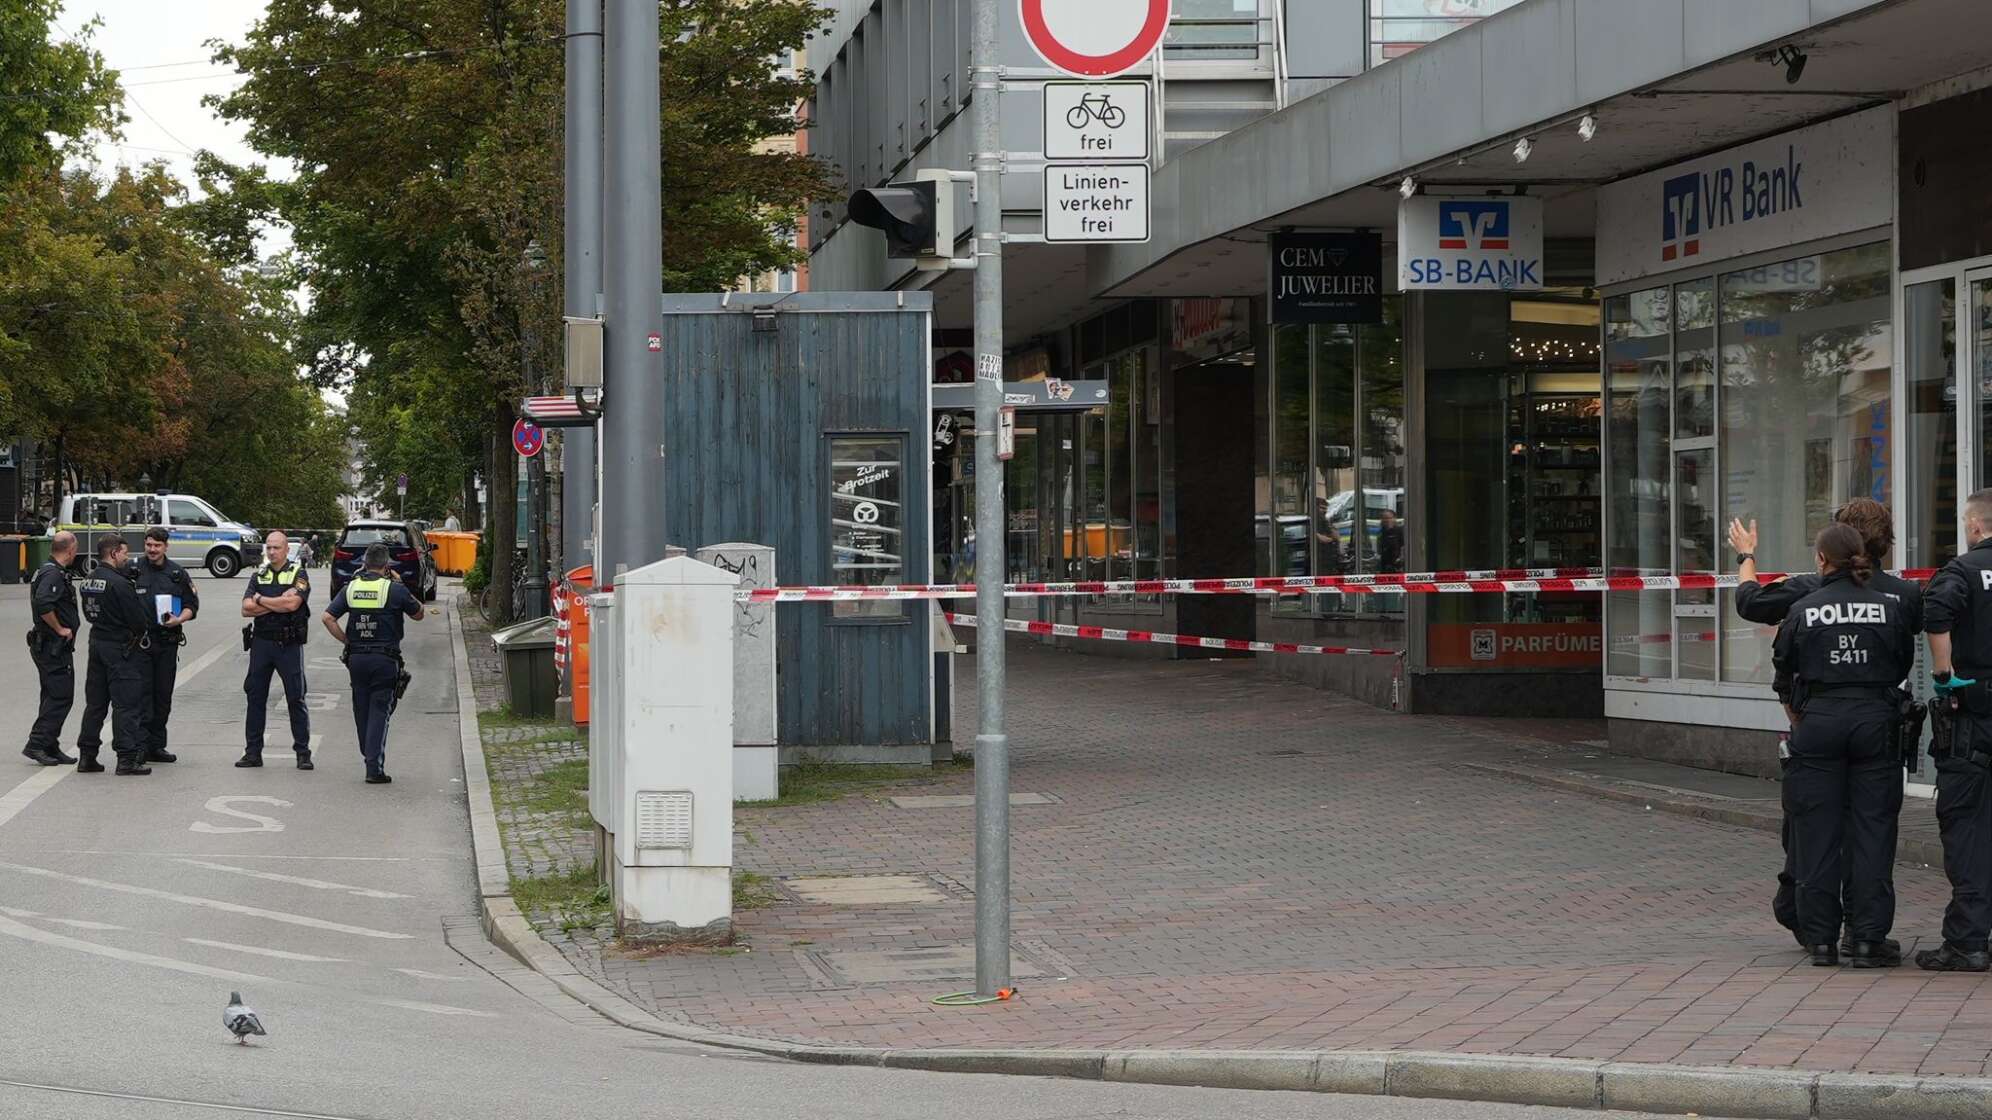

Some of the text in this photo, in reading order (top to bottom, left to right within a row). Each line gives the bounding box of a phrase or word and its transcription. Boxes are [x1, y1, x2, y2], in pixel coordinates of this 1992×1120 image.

[1081, 134, 1112, 150] frei
[1063, 173, 1129, 190] Linien-
[1703, 144, 1803, 230] VR Bank
[1060, 195, 1133, 211] verkehr
[1081, 216, 1113, 233] frei
[1280, 247, 1325, 268] CEM
[1409, 258, 1539, 285] SB-BANK
[1277, 275, 1376, 299] JUWELIER
[856, 464, 877, 477] Zur
[845, 469, 890, 490] Brotzeit
[81, 578, 106, 592] POLIZEI
[353, 591, 378, 599] POLIZEI
[1805, 602, 1887, 628] POLIZEI
[1501, 631, 1600, 652] PARFÜME
[1838, 635, 1859, 649] BY
[1829, 650, 1868, 665] 5411
